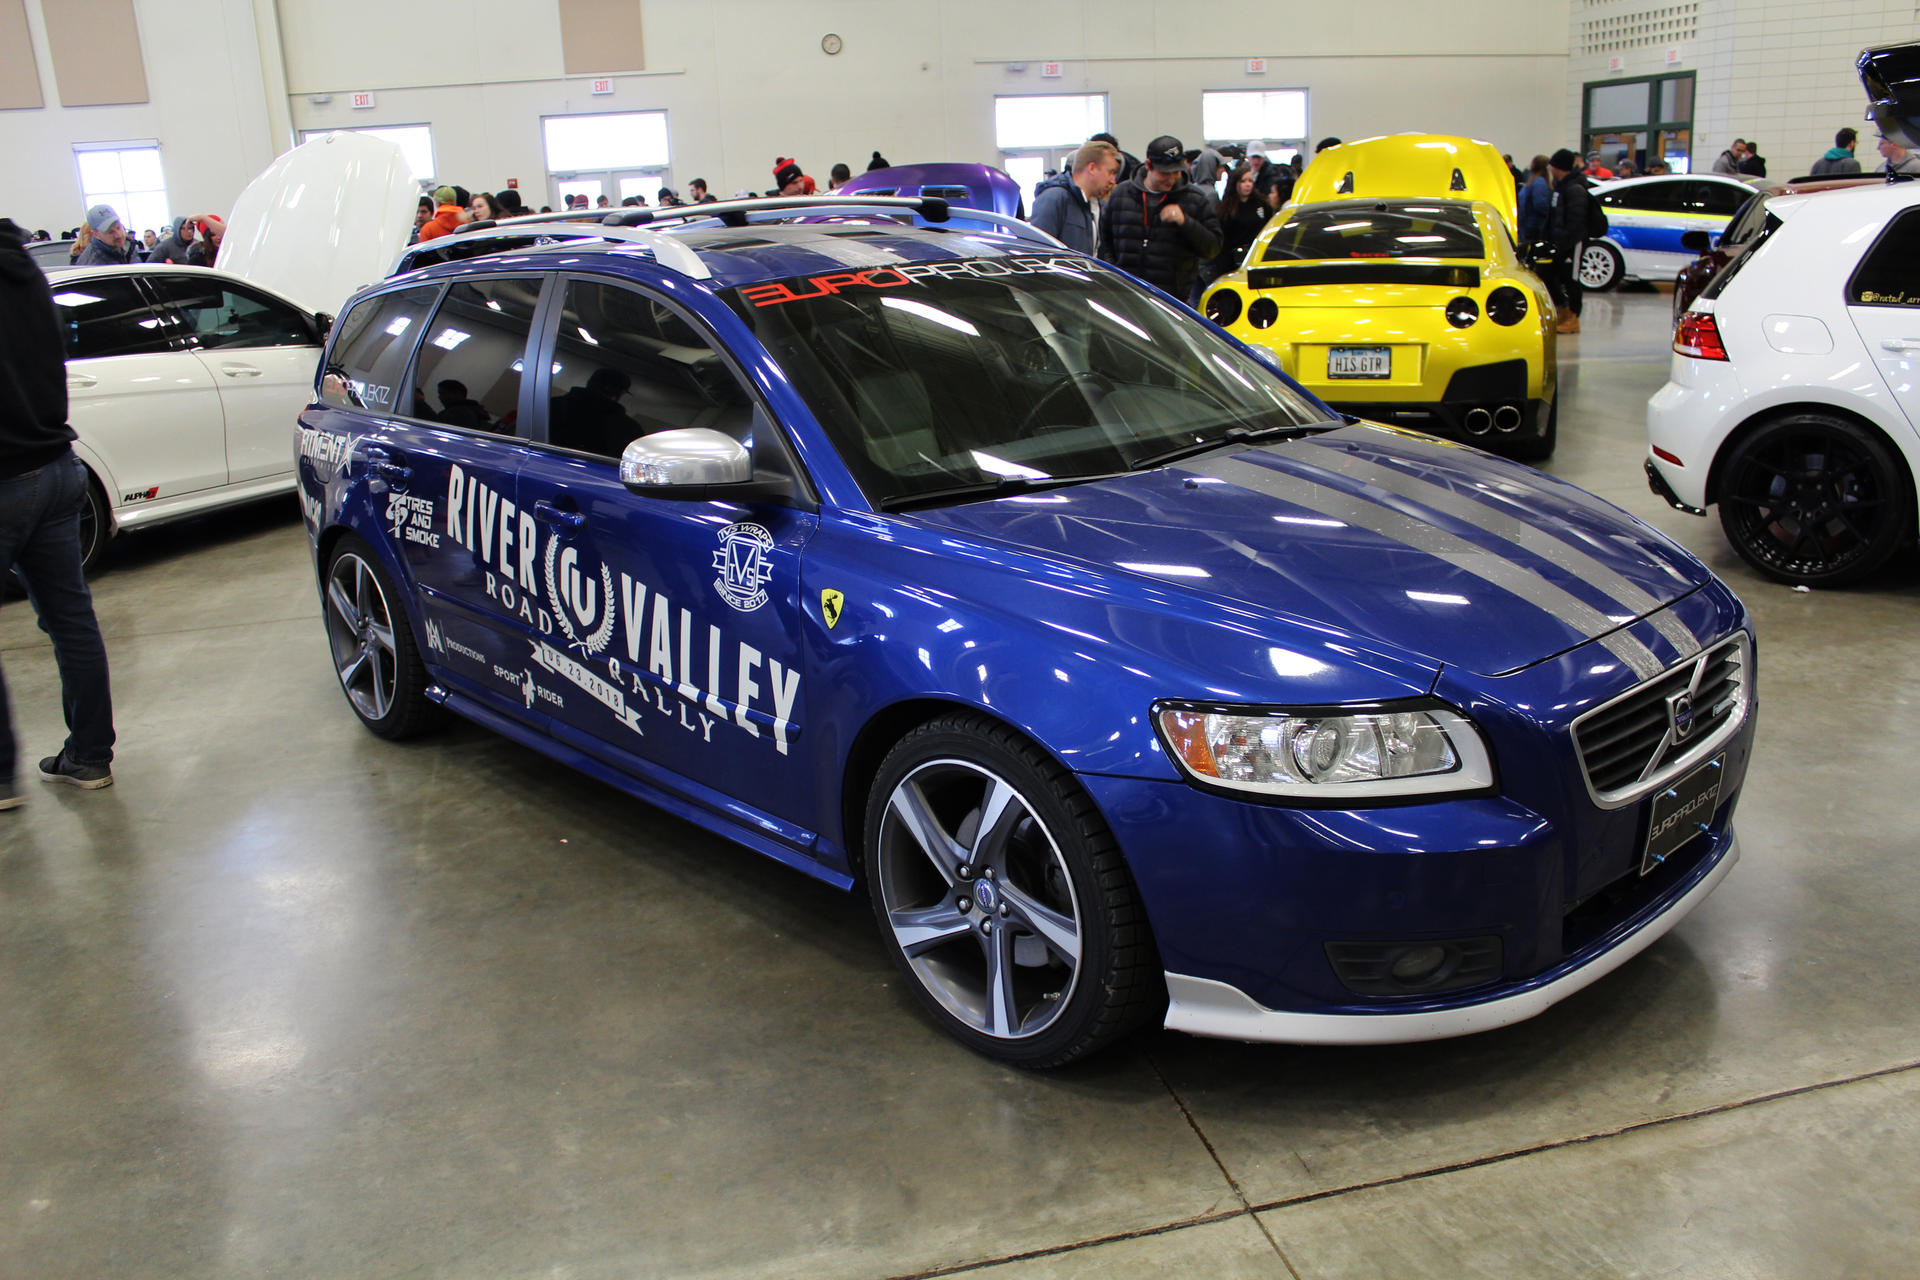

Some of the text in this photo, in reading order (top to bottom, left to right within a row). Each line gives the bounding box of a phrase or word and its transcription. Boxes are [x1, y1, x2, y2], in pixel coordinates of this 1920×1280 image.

[594, 80, 609, 92] EXIT
[354, 94, 369, 106] EXIT
[1335, 357, 1382, 372] HIS GTR
[406, 495, 434, 516] TIRES
[410, 512, 432, 530] AND
[405, 526, 440, 549] SMOKE
[720, 524, 772, 549] IVS WRAPS
[728, 542, 756, 588] IVS
[715, 579, 766, 609] SINCE 2017
[446, 463, 538, 597] RIVER
[621, 571, 801, 756] VALLEY
[485, 570, 554, 636] ROAD
[607, 656, 716, 744] RALLY
[493, 664, 564, 709] SPORT RIDER
